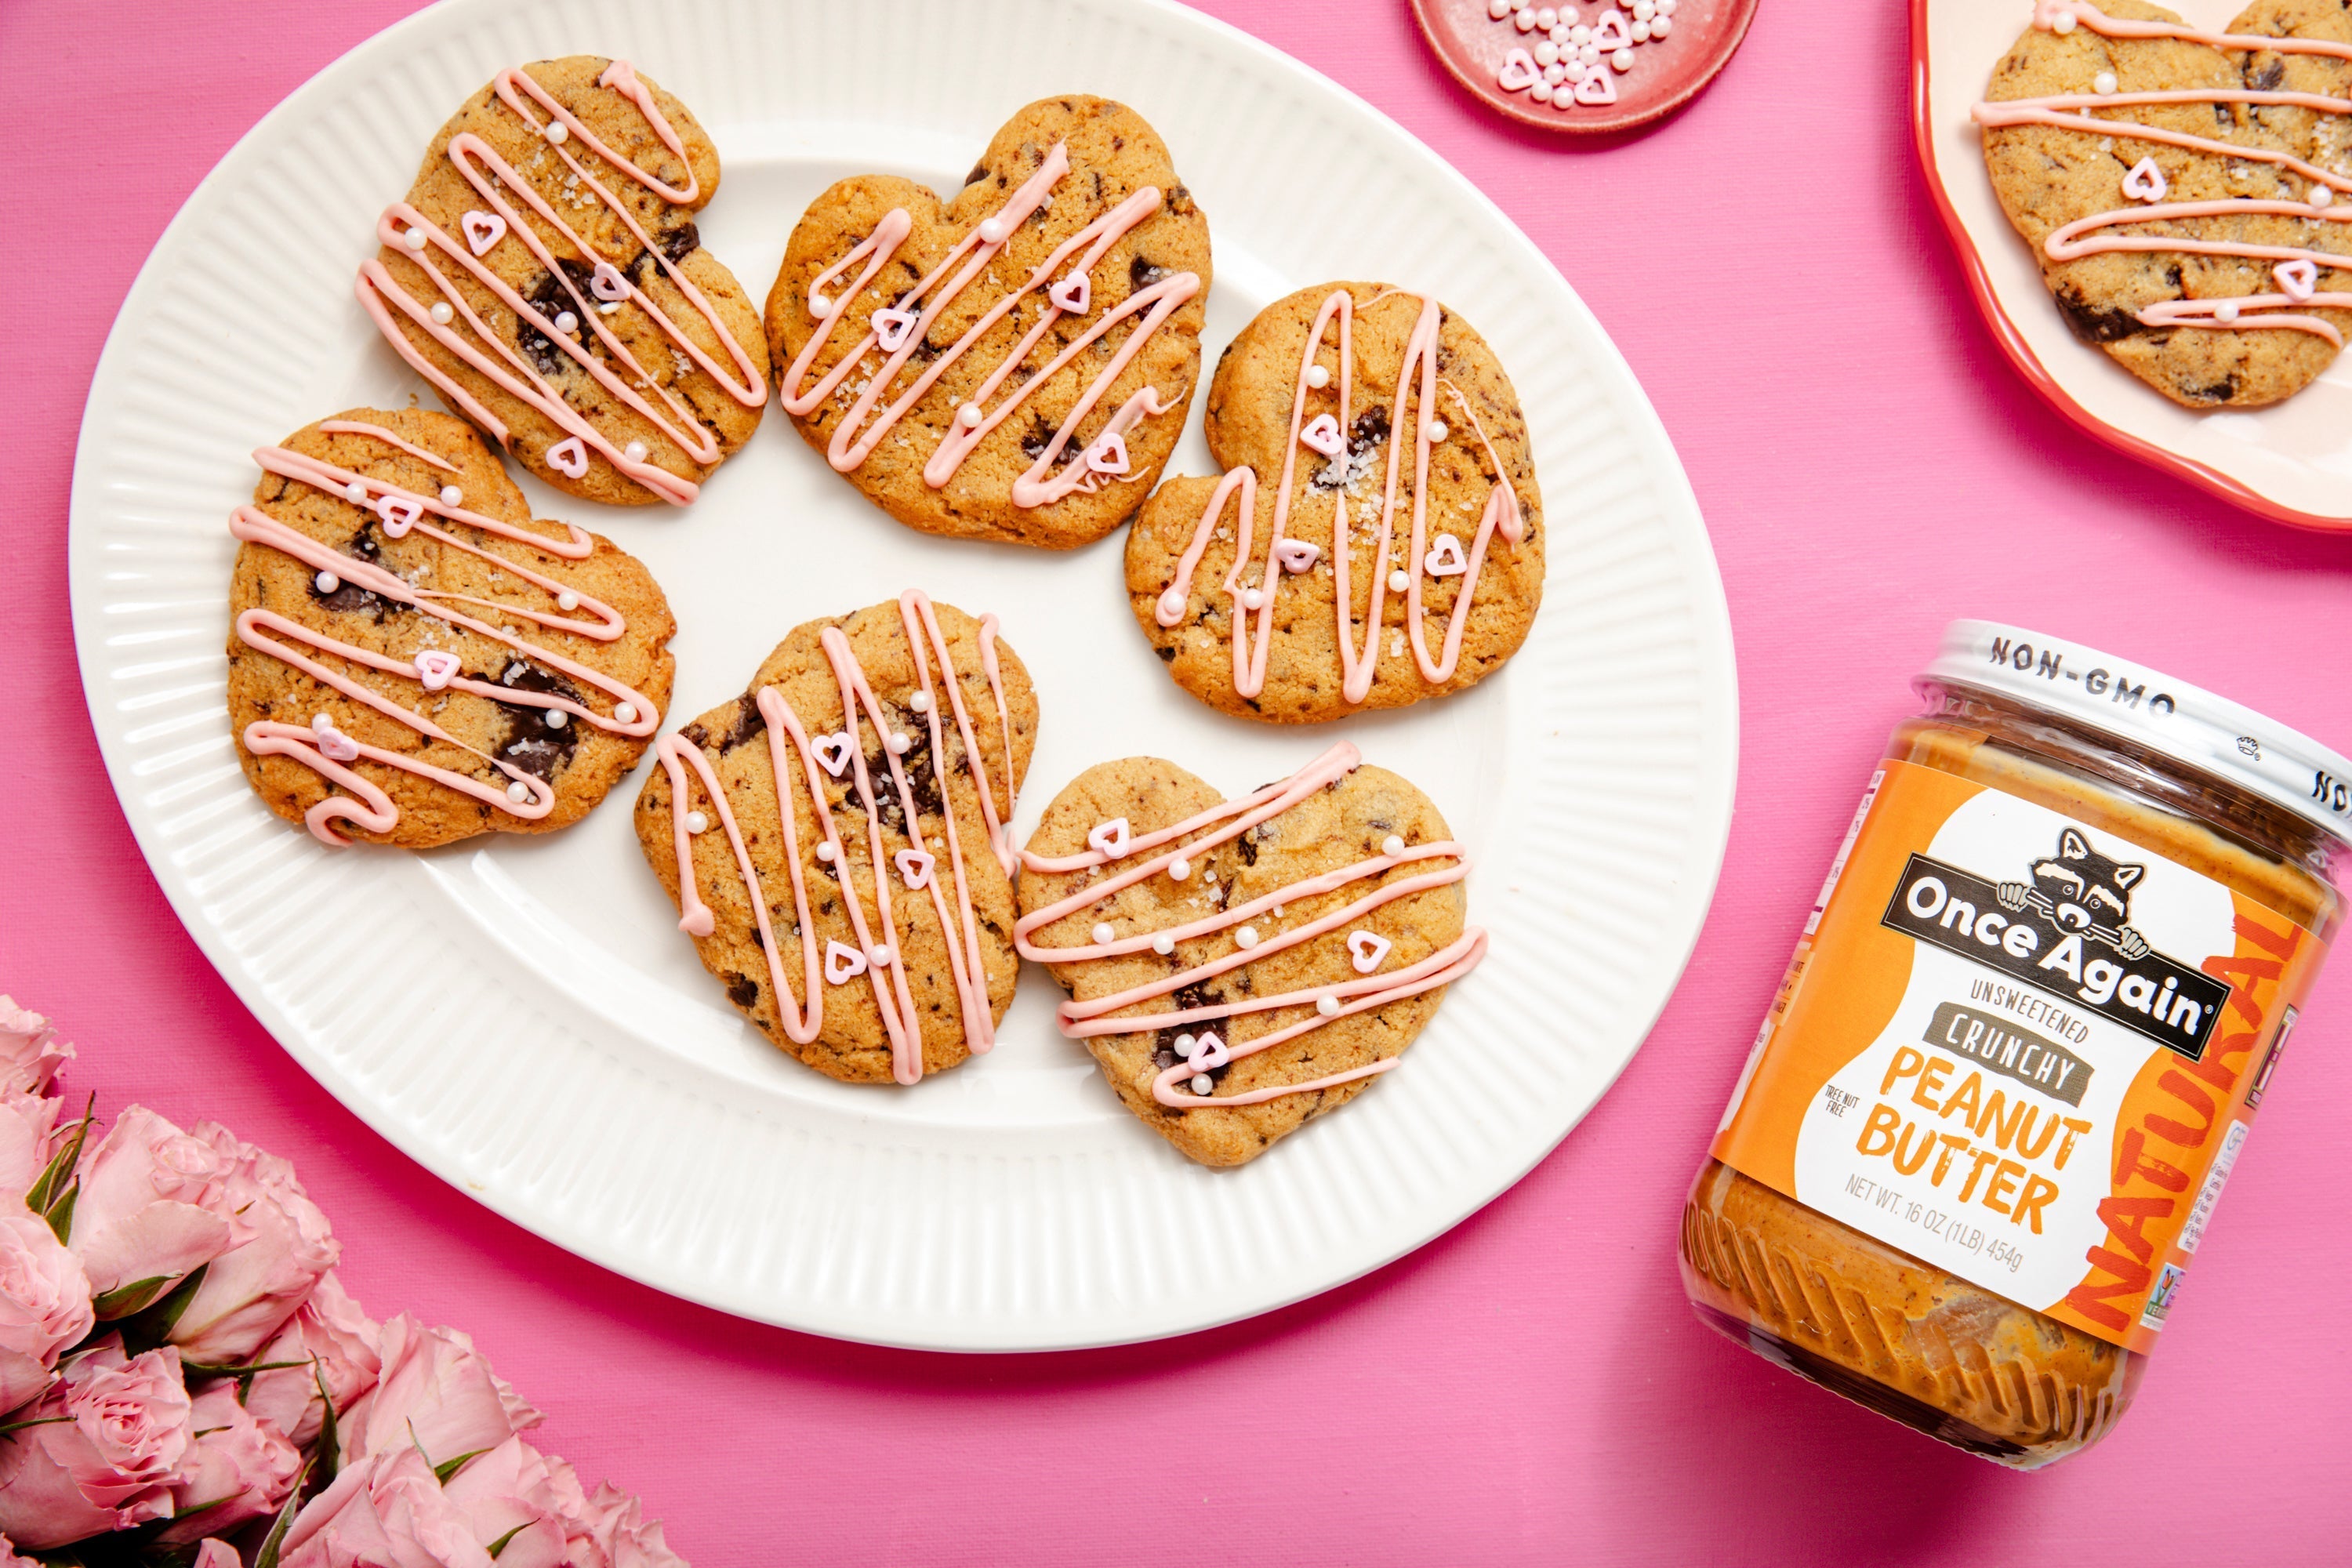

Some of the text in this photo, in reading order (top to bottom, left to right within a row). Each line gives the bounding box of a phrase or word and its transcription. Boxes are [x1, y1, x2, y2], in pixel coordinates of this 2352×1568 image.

[1989, 636, 2176, 719] NON-GMO
[2311, 771, 2352, 818] NO
[1906, 876, 2038, 958] Once
[1945, 1012, 2076, 1091] CRUNCHY
[1970, 978, 2089, 1044] UNSWEETENED
[1825, 1084, 1860, 1109] TREE NUT
[1825, 1100, 1846, 1117] FREE
[1879, 1045, 2092, 1171] PEANUT
[2065, 913, 2303, 1332] NATURAL
[1856, 1102, 2059, 1235] BUTTER
[1845, 1174, 2024, 1273] NET WT. 16 OZ (1LB) 454g
